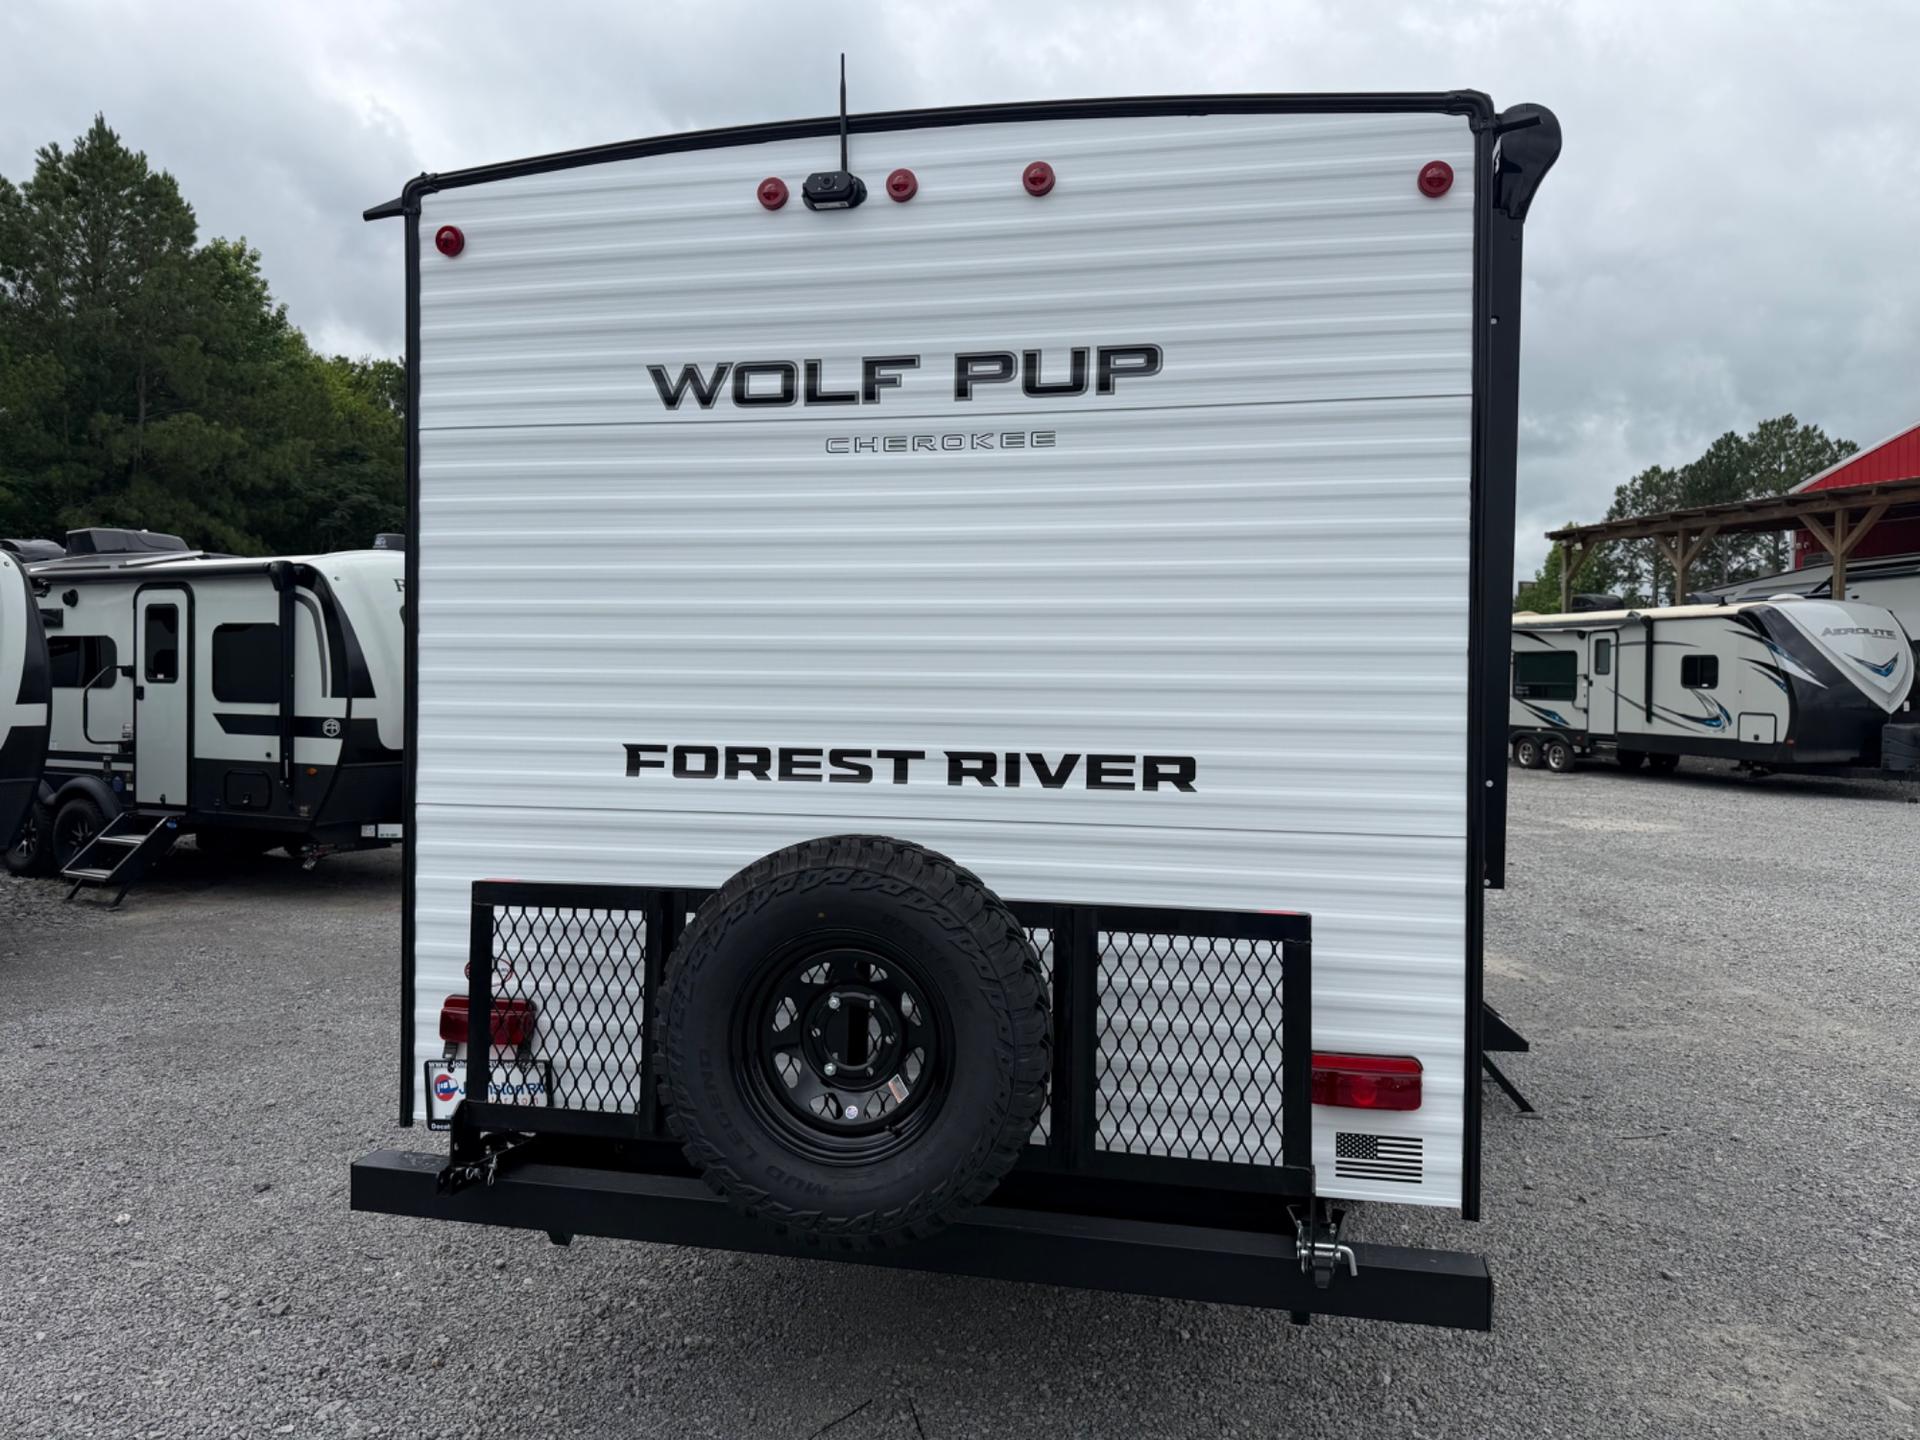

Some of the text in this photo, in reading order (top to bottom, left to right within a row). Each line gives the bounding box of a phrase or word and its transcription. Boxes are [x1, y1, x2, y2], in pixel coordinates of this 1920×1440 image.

[646, 343, 1164, 411] WOLF PUP
[825, 430, 1057, 455] CHEROKEE
[622, 743, 1198, 792] FOREST RIVER
